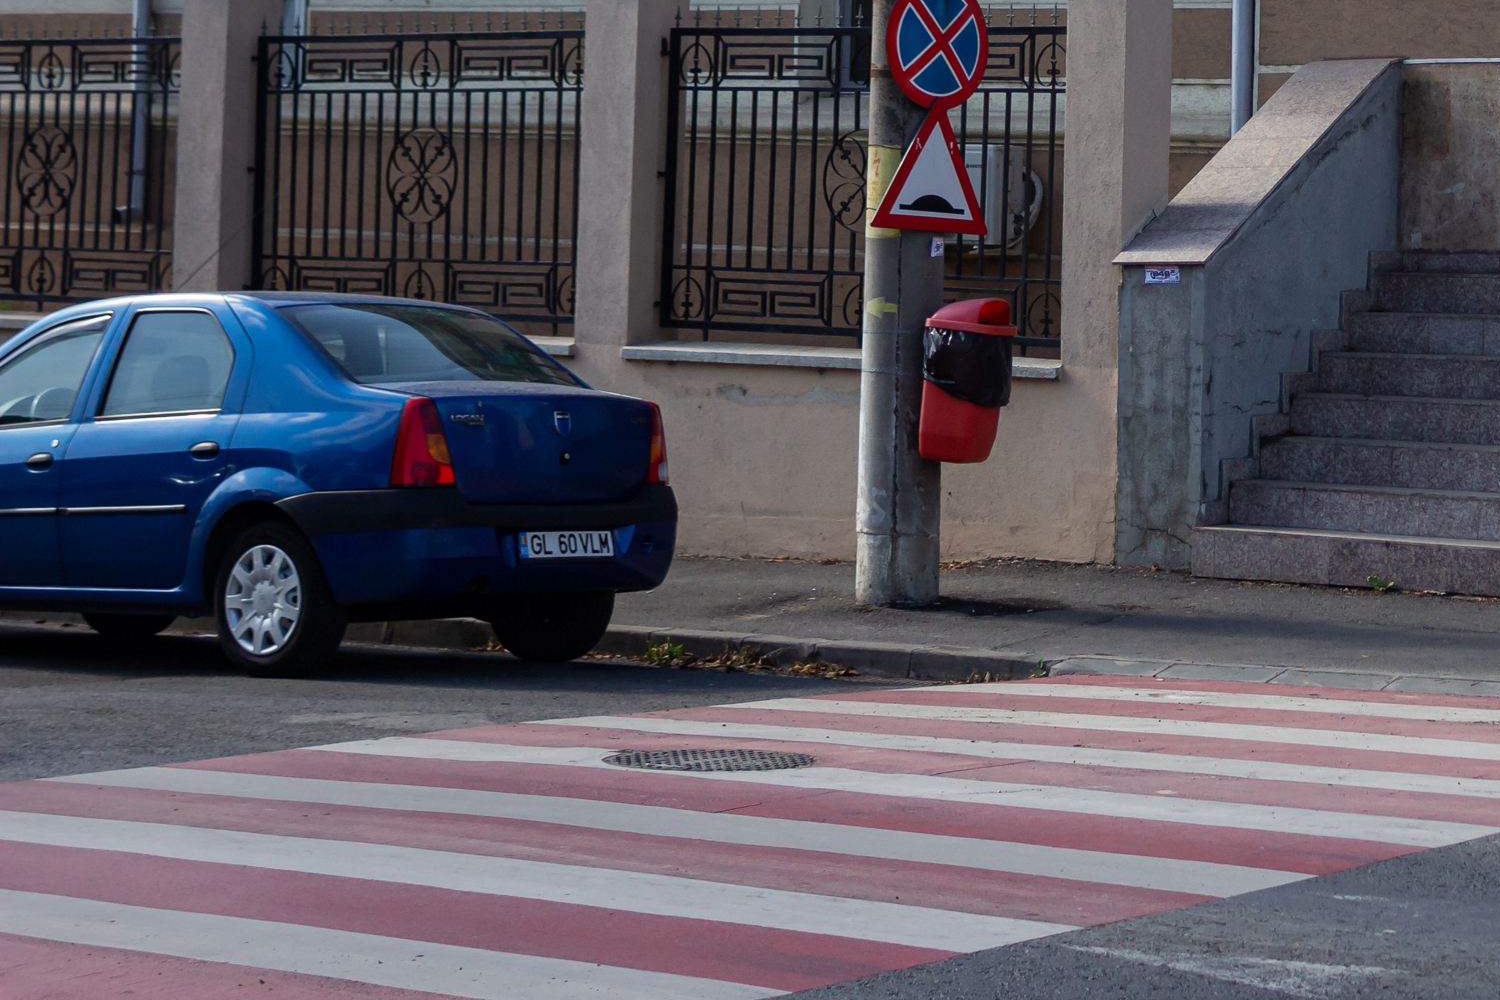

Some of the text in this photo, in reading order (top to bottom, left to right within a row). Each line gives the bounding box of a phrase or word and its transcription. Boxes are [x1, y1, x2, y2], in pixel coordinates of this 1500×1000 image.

[530, 533, 610, 555] GL 60 VLM
